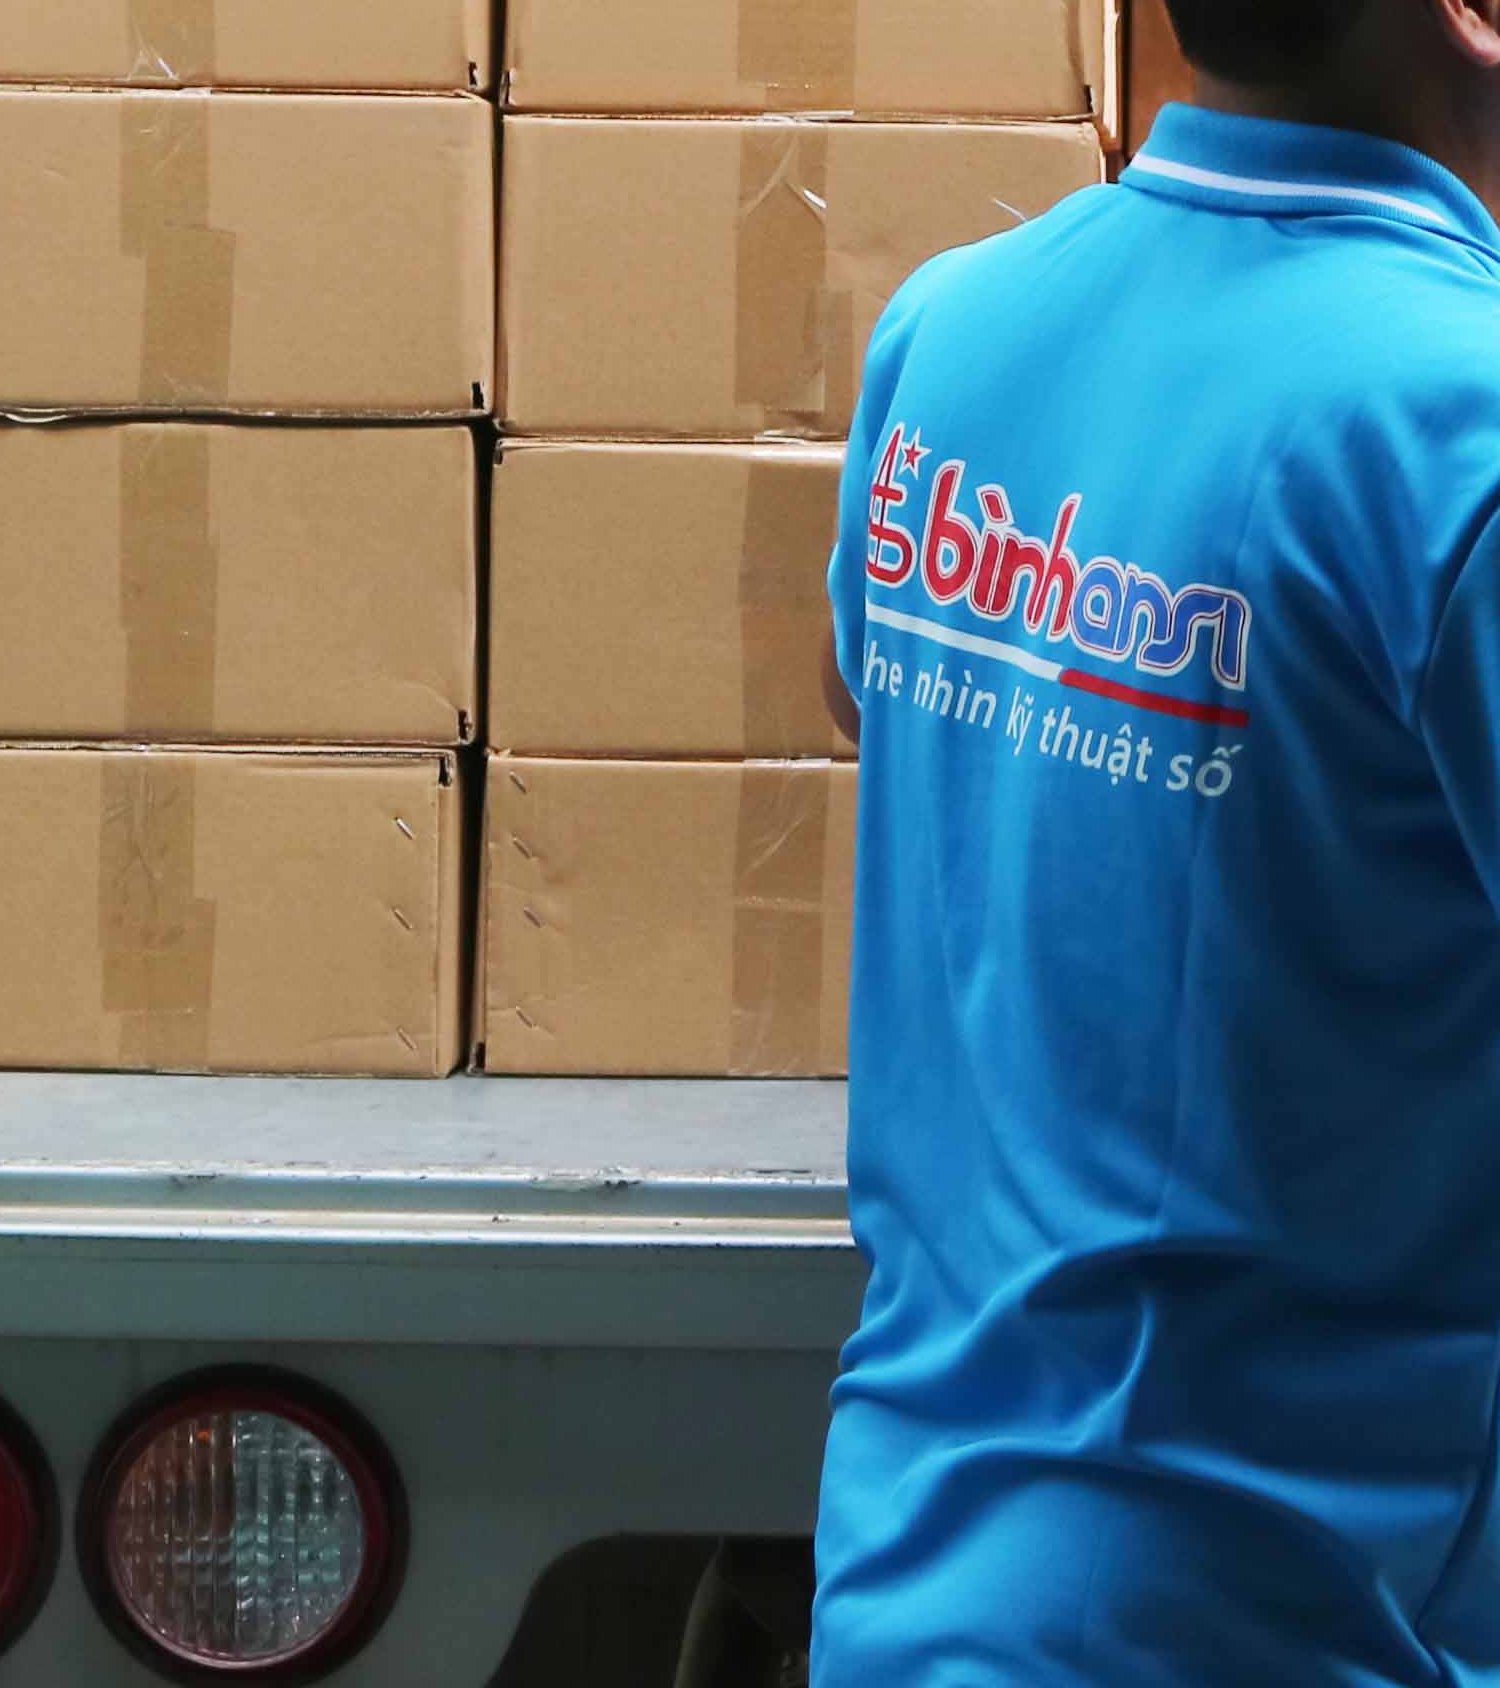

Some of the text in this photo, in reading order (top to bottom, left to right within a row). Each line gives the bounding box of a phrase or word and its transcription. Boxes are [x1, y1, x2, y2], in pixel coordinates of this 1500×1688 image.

[863, 639, 904, 697] he
[913, 662, 997, 729] nhìn
[1038, 706, 1153, 786] thuật
[1166, 744, 1244, 798] số
